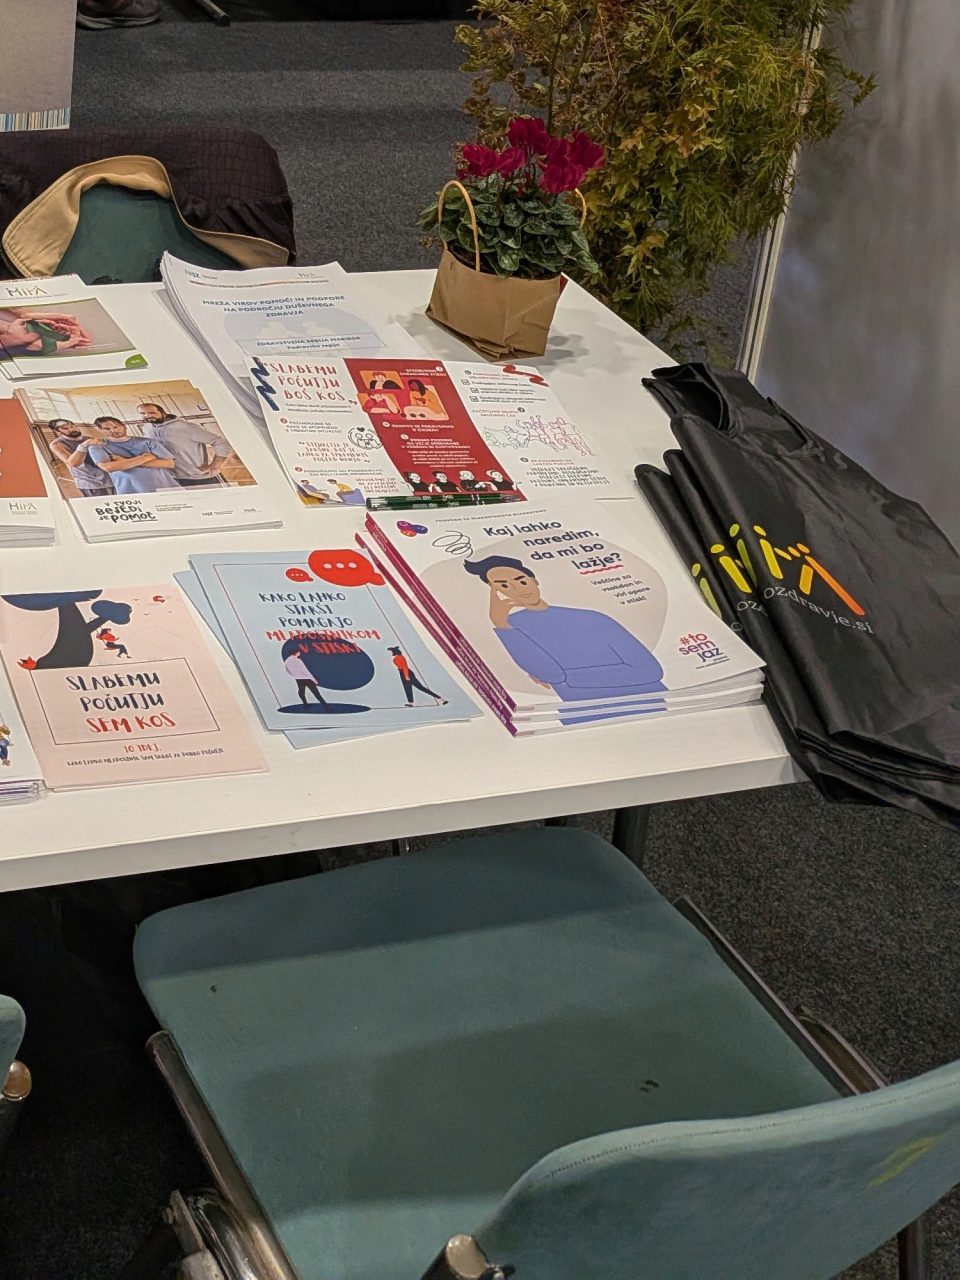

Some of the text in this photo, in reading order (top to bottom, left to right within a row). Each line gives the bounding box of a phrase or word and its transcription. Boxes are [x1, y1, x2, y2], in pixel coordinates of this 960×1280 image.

[484, 520, 562, 537] Kaj lahko
[523, 528, 600, 547] naredim,
[530, 542, 605, 560] da mi bo
[571, 552, 623, 570] lažje?
[258, 591, 346, 605] KAKO LAHKO
[278, 615, 353, 629] POMAGAJO
[265, 629, 381, 641] MLADOSTNIKOM
[679, 632, 708, 646] #to
[678, 638, 716, 656] sem
[698, 645, 725, 663] jaz
[66, 671, 161, 692] SLABEMU
[79, 692, 165, 712] POČUTJU
[86, 712, 176, 734] SEM KOS
